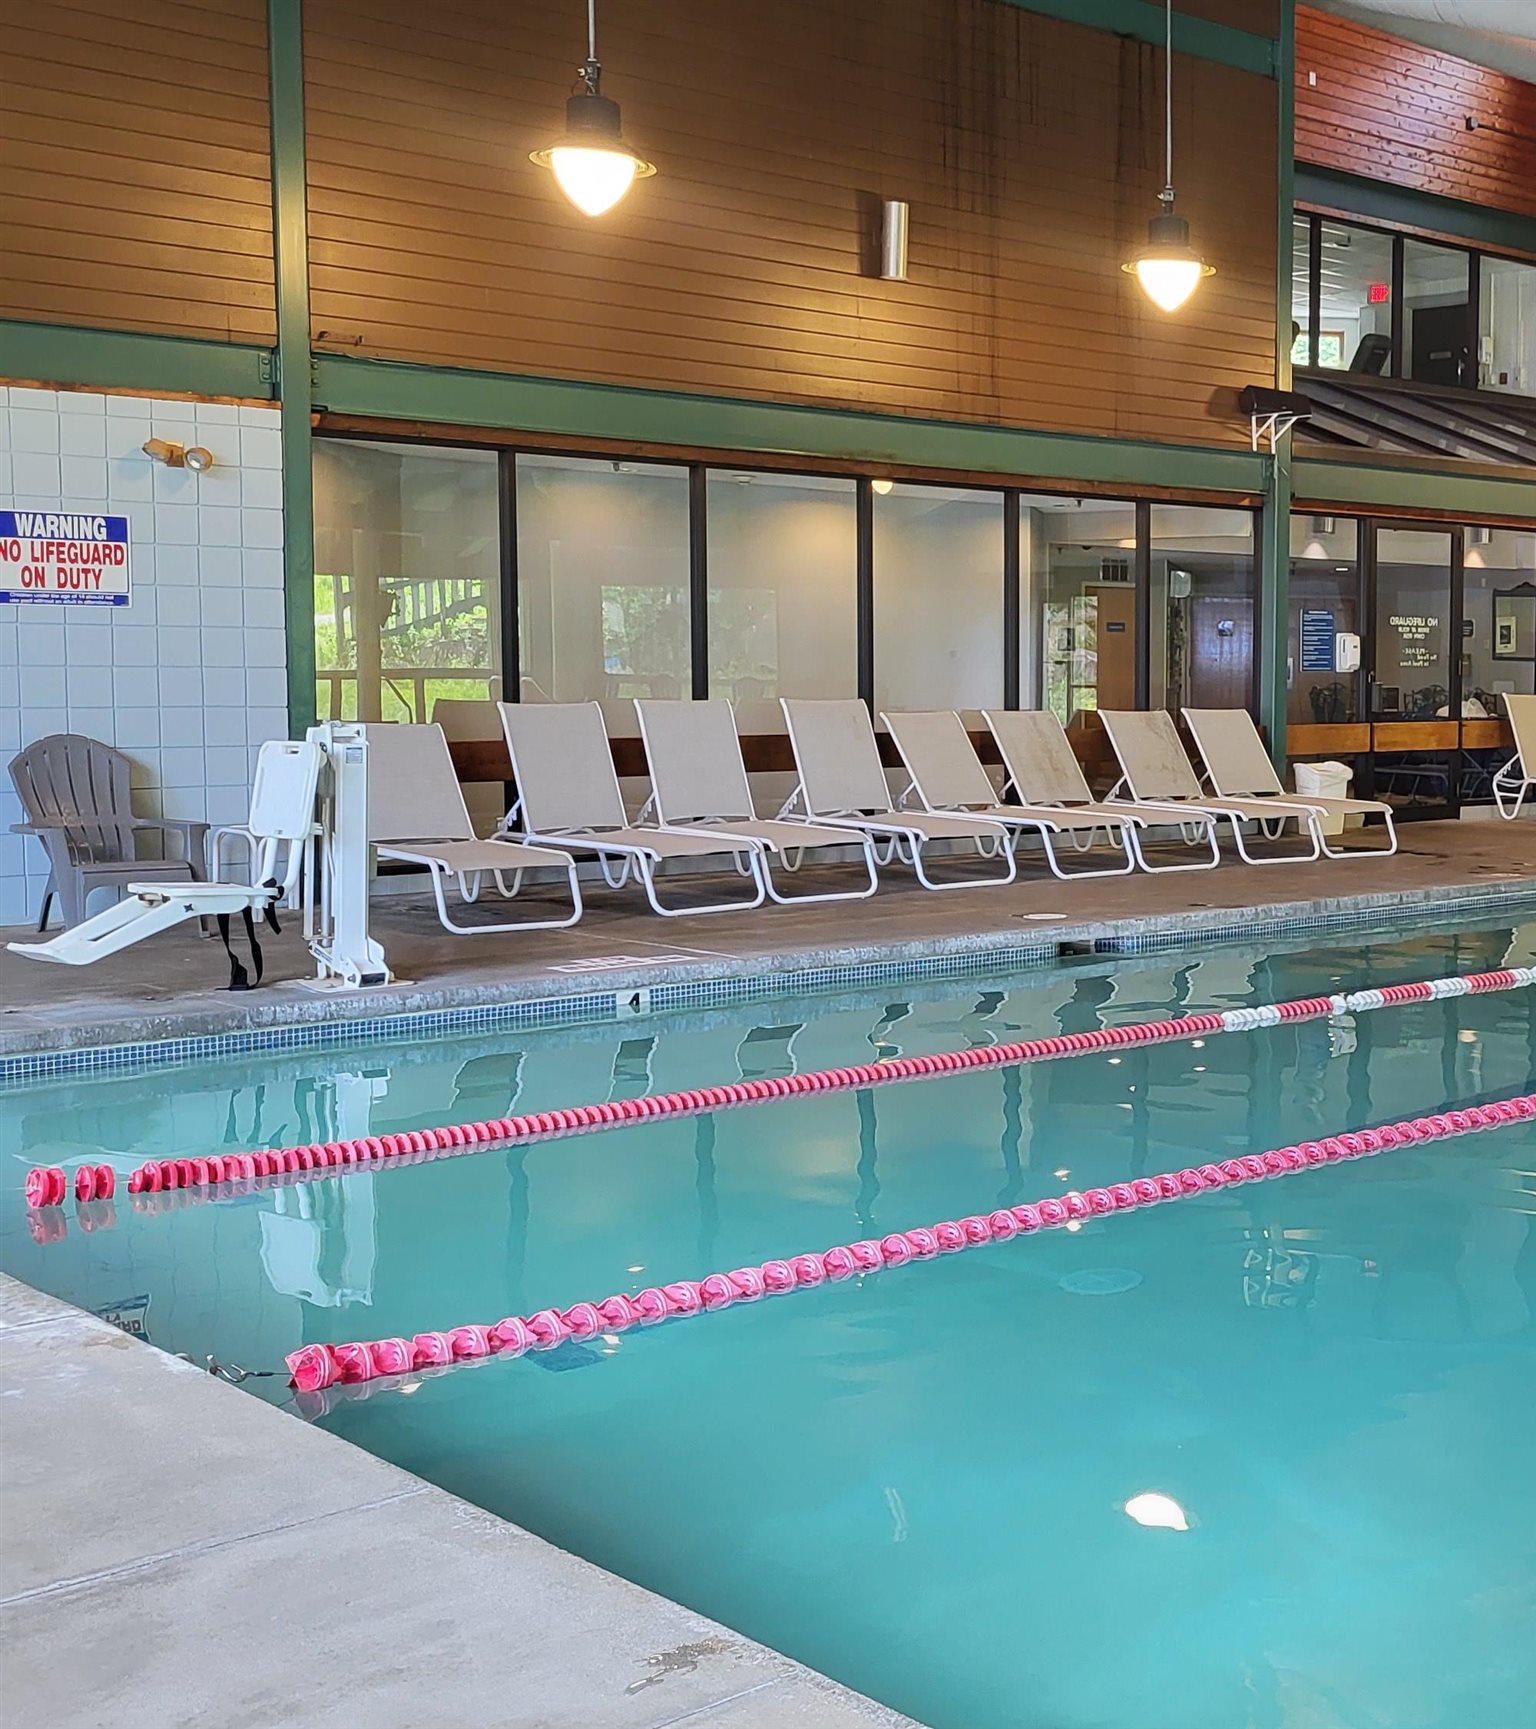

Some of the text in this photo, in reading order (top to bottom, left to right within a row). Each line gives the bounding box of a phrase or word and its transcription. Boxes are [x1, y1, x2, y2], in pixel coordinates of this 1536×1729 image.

[14, 513, 107, 541] WARNING
[0, 540, 125, 566] NO LIFEGUARD
[21, 565, 103, 590] ON DUTY
